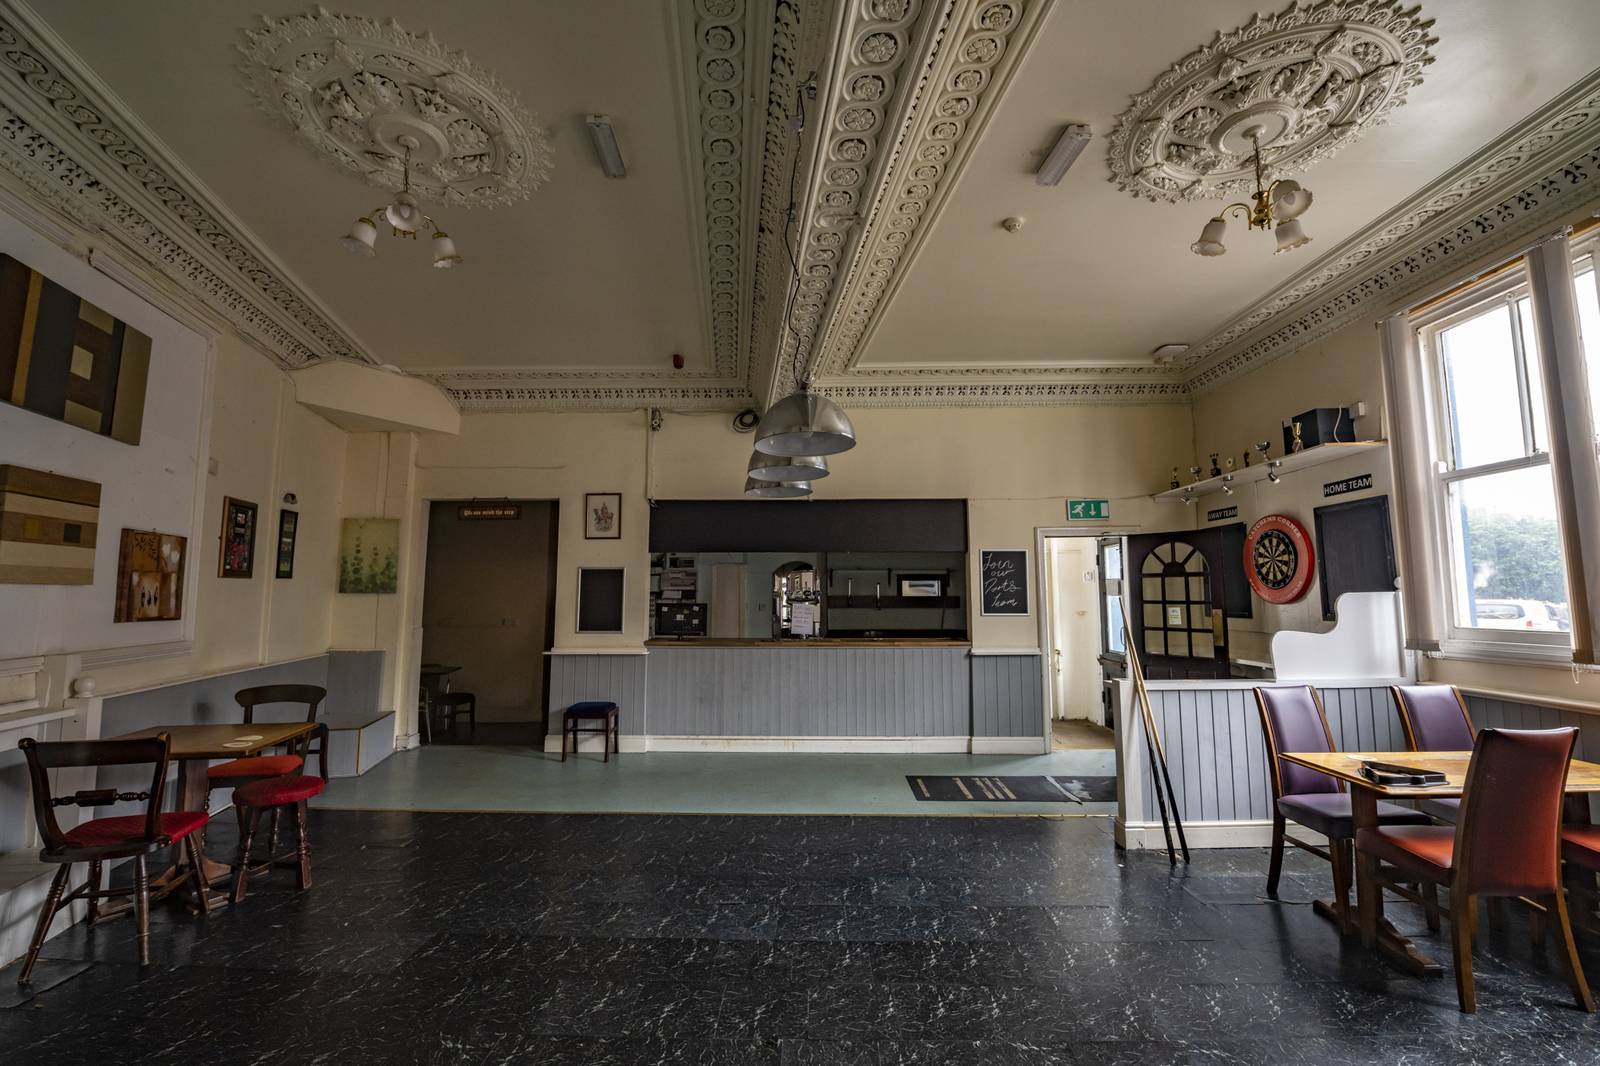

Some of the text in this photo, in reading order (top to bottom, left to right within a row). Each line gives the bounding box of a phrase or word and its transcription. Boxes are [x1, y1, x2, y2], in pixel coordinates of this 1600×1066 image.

[1324, 477, 1372, 495] HOME TEAM
[1208, 508, 1238, 520] AWAY TEAM
[1277, 516, 1302, 539] CORNER
[990, 569, 1016, 577] our
